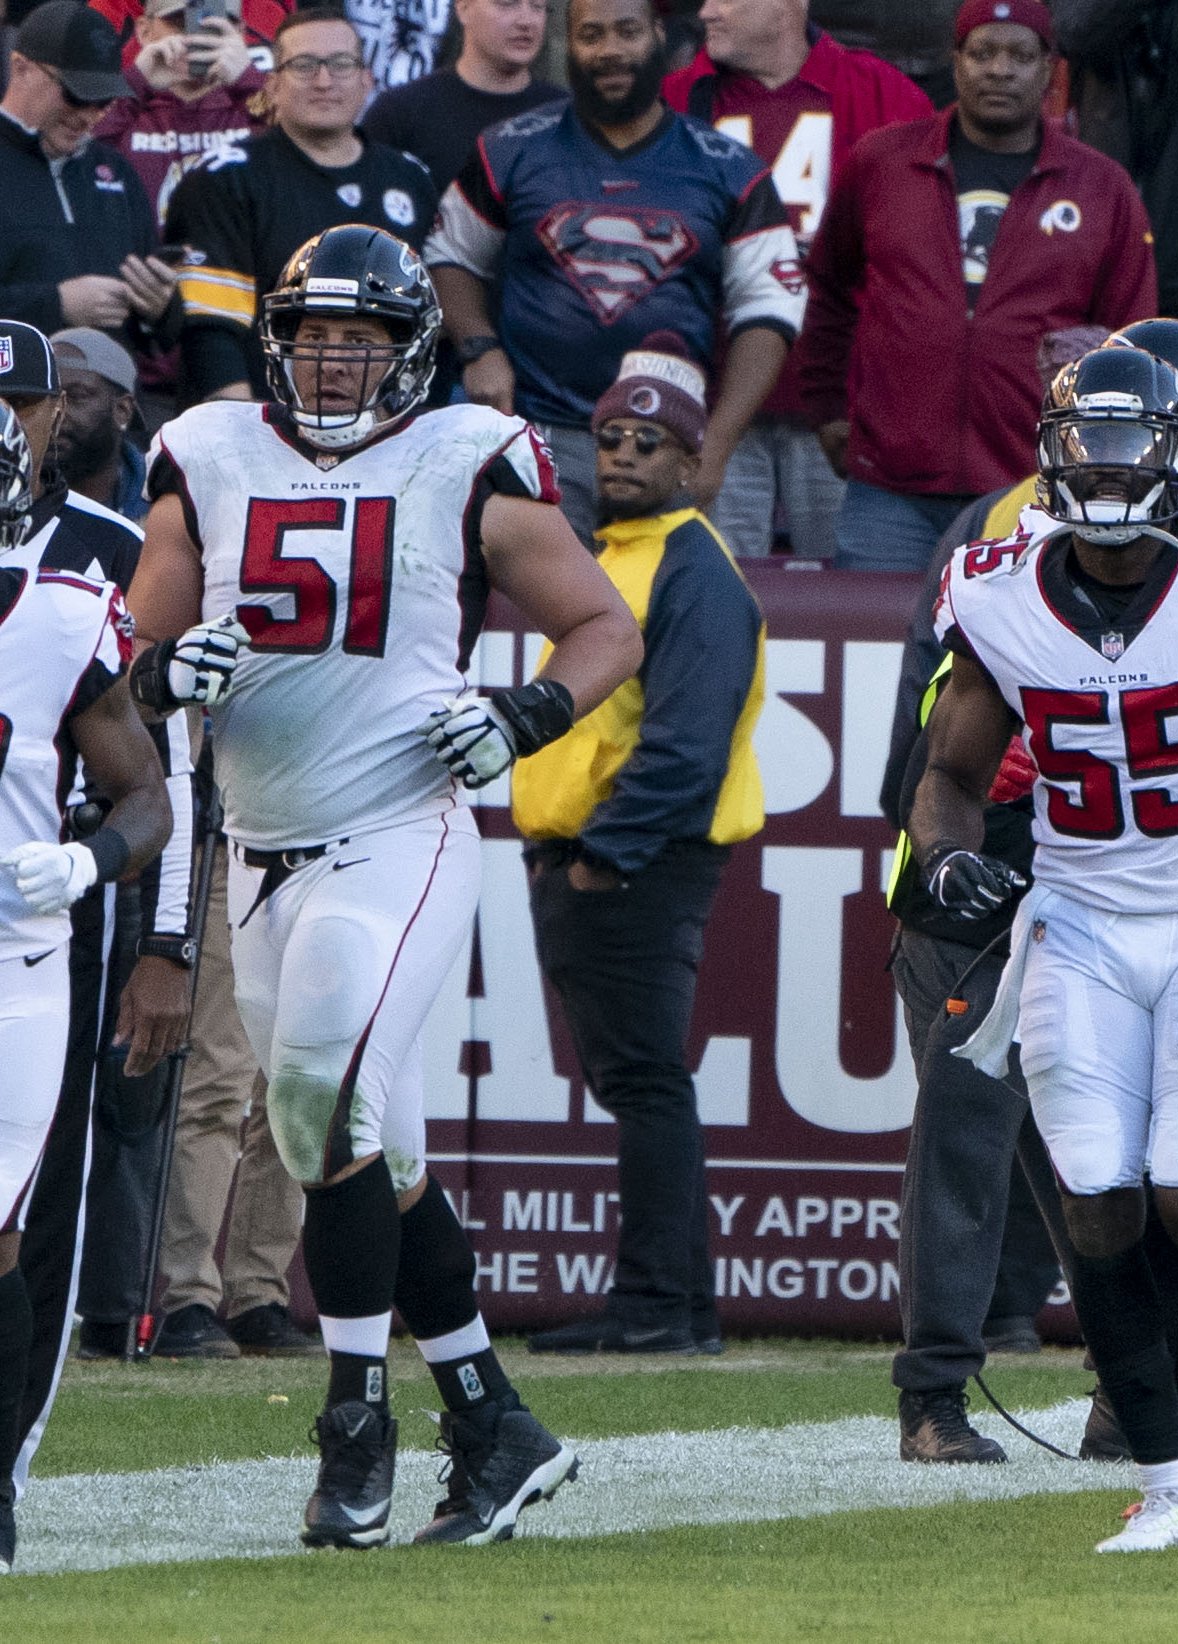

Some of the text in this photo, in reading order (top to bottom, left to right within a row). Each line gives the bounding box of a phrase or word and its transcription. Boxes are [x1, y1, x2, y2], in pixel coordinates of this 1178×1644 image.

[291, 482, 361, 490] FALCONS
[235, 495, 397, 659] 51
[1079, 673, 1148, 685] FALCONS
